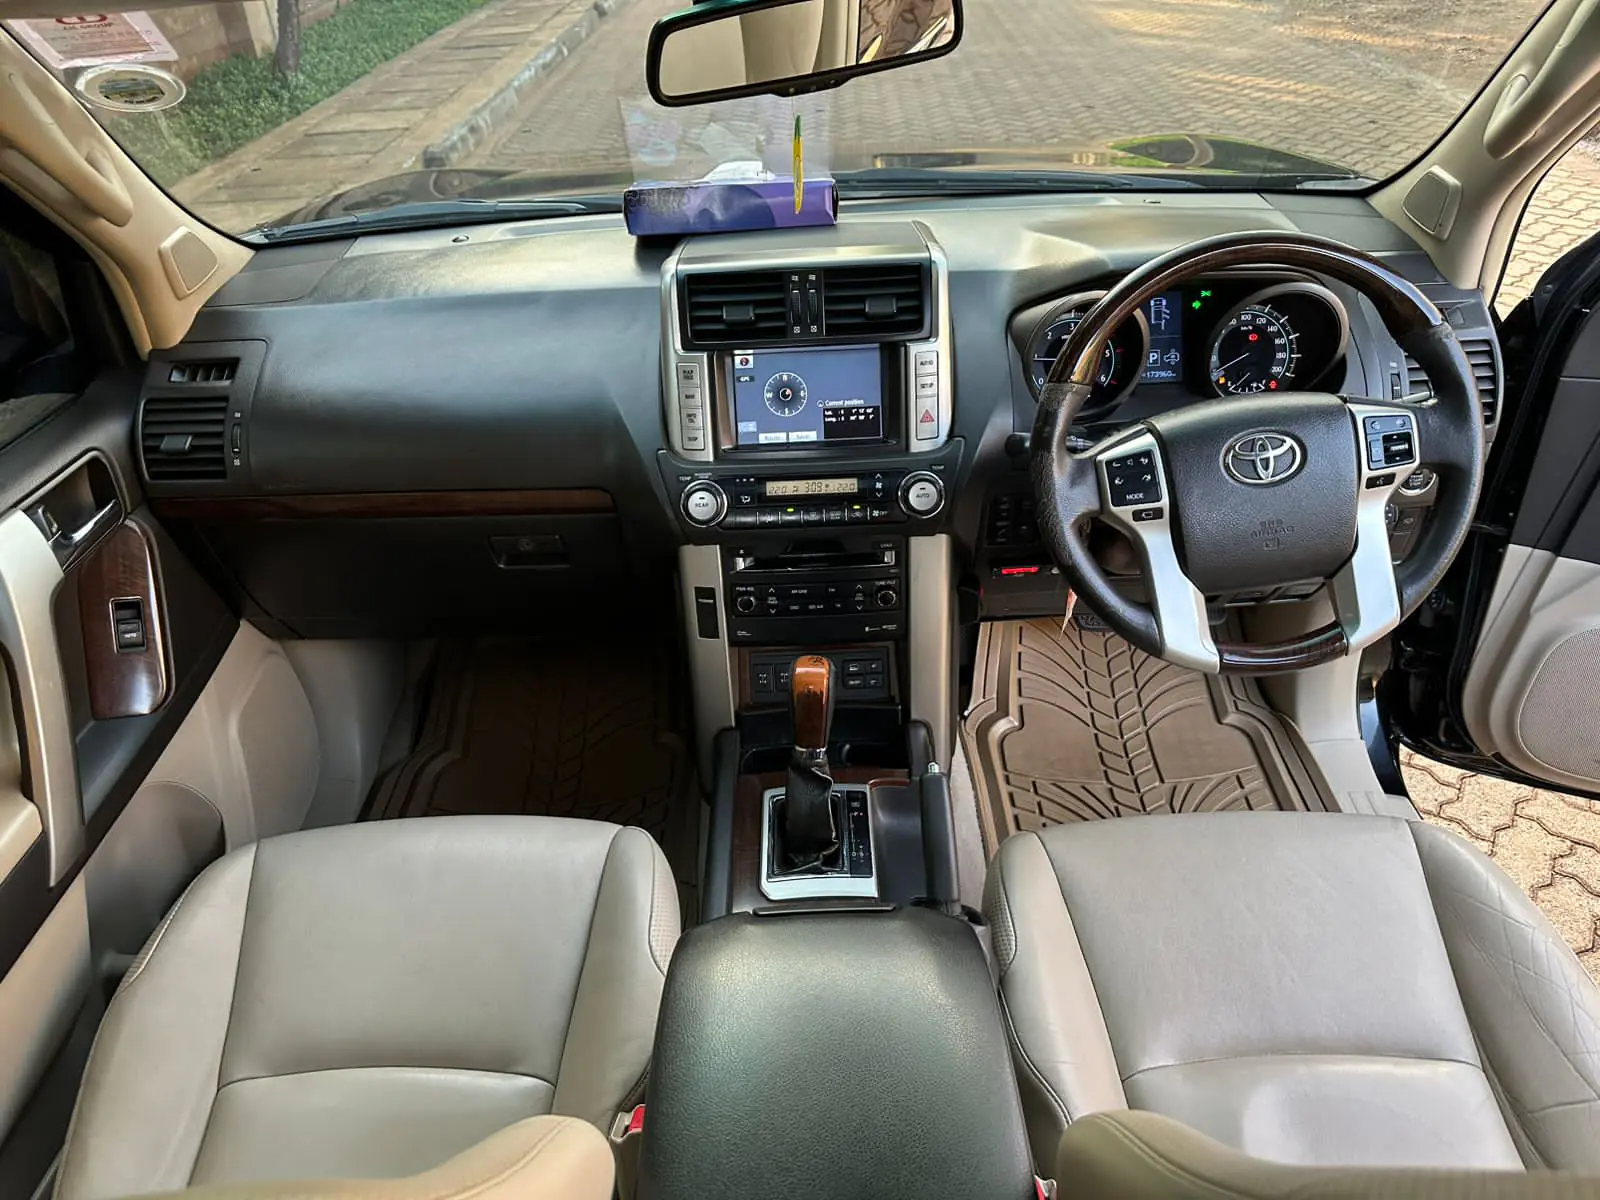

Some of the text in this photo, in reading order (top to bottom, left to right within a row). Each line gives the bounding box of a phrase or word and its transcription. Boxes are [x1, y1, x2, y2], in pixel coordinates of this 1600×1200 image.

[1256, 317, 1267, 325] 120
[1069, 322, 1075, 331] 3
[1047, 331, 1053, 340] 2
[1105, 349, 1111, 358] 5
[1150, 352, 1158, 364] P
[1038, 377, 1044, 385] 0
[1100, 374, 1106, 382] 6
[825, 399, 864, 407] Current position
